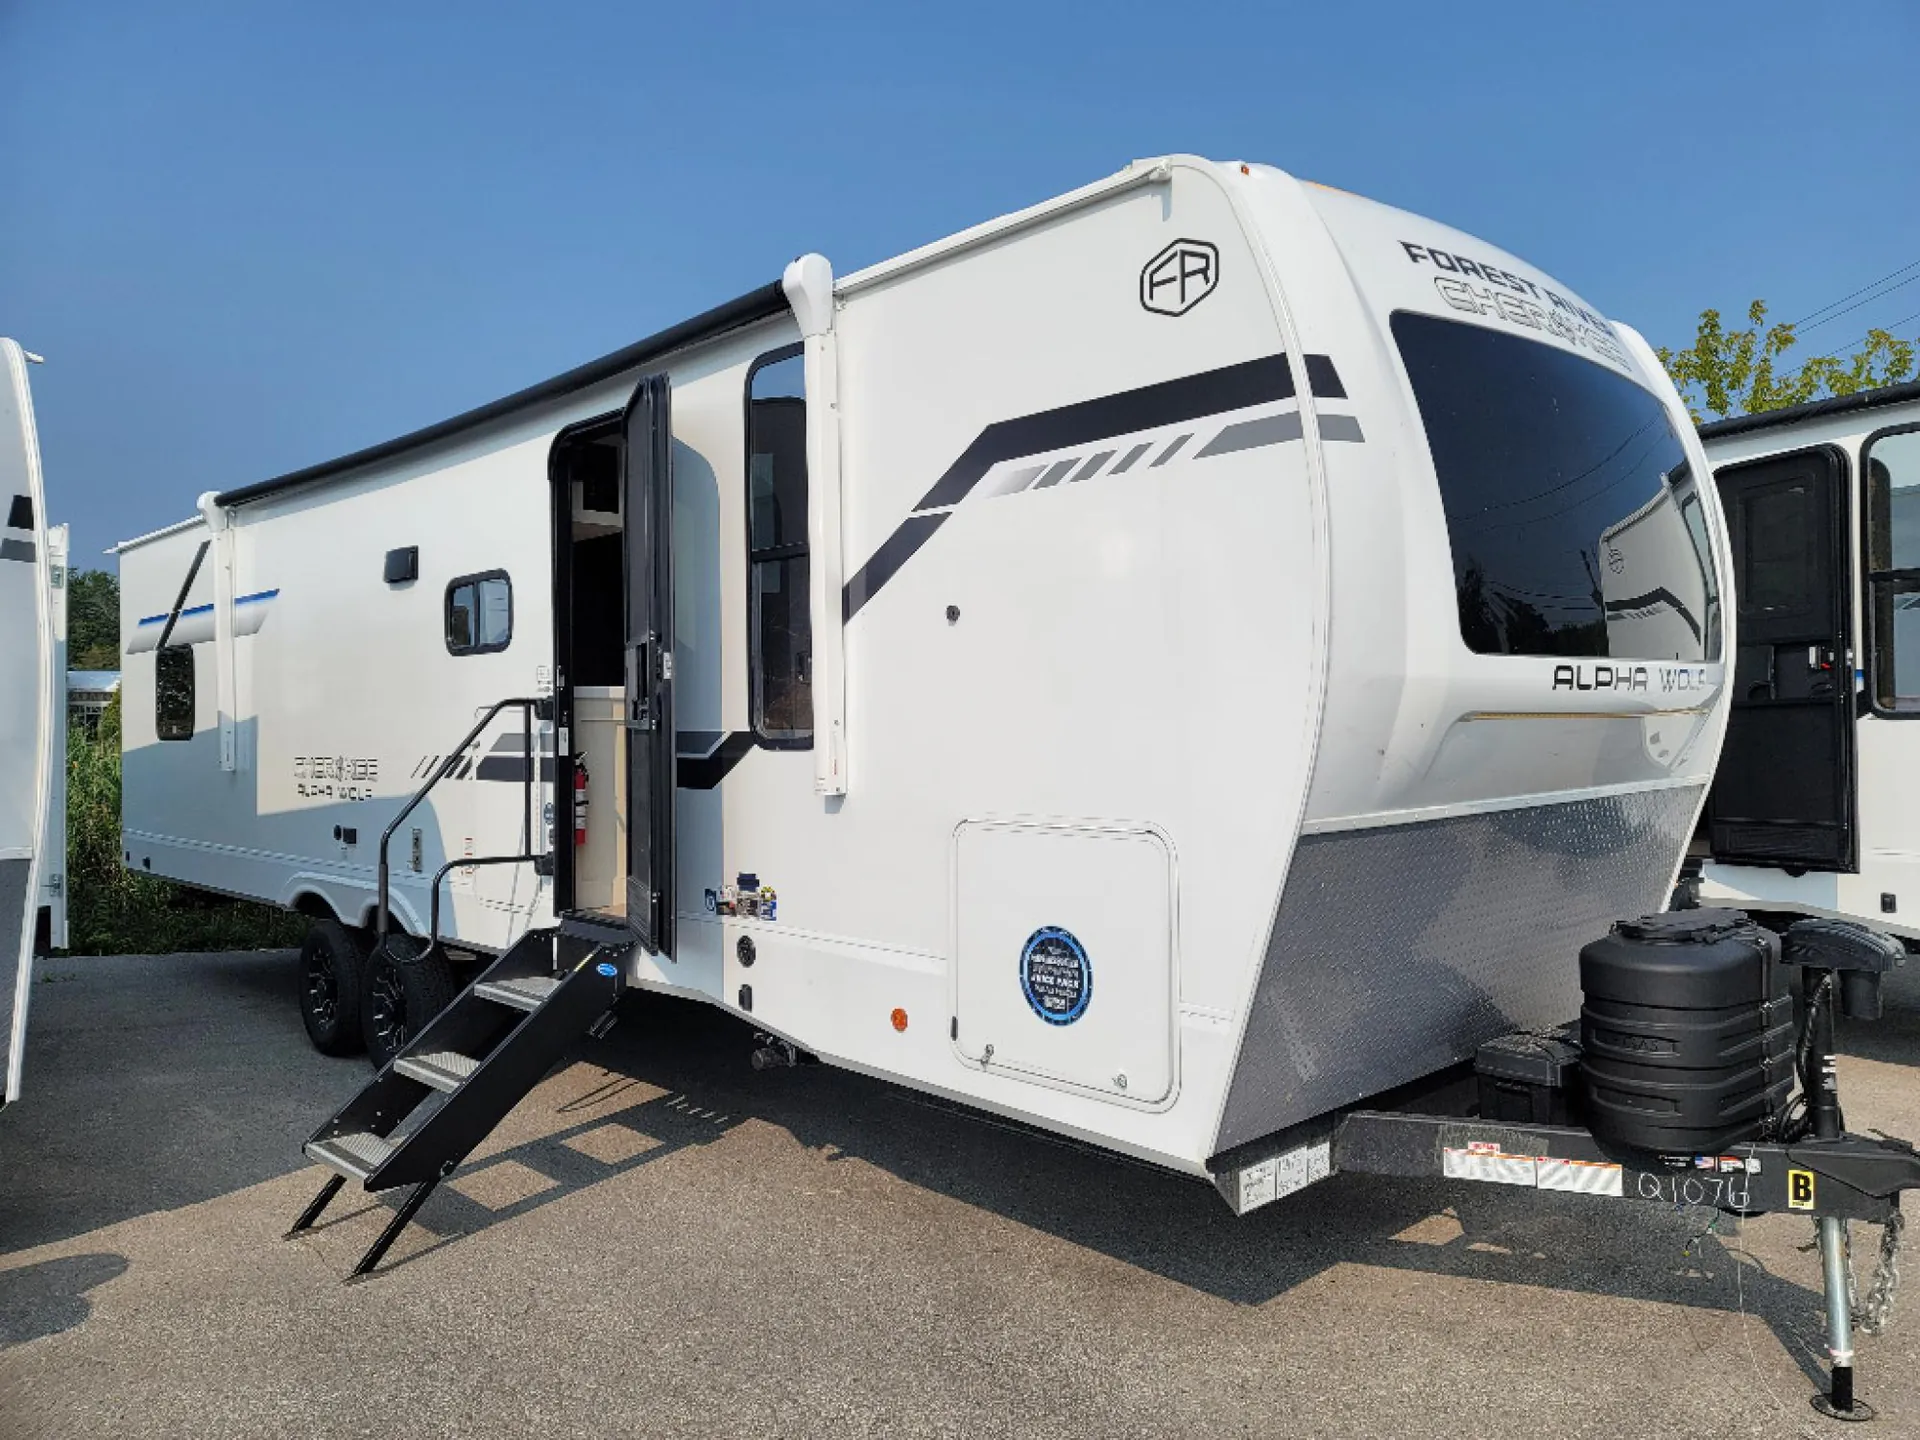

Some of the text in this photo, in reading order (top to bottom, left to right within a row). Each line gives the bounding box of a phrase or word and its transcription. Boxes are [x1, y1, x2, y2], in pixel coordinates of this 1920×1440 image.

[1398, 240, 1541, 300] FOREST
[1552, 665, 1648, 691] ALPHA
[1792, 1173, 1812, 1201] B
